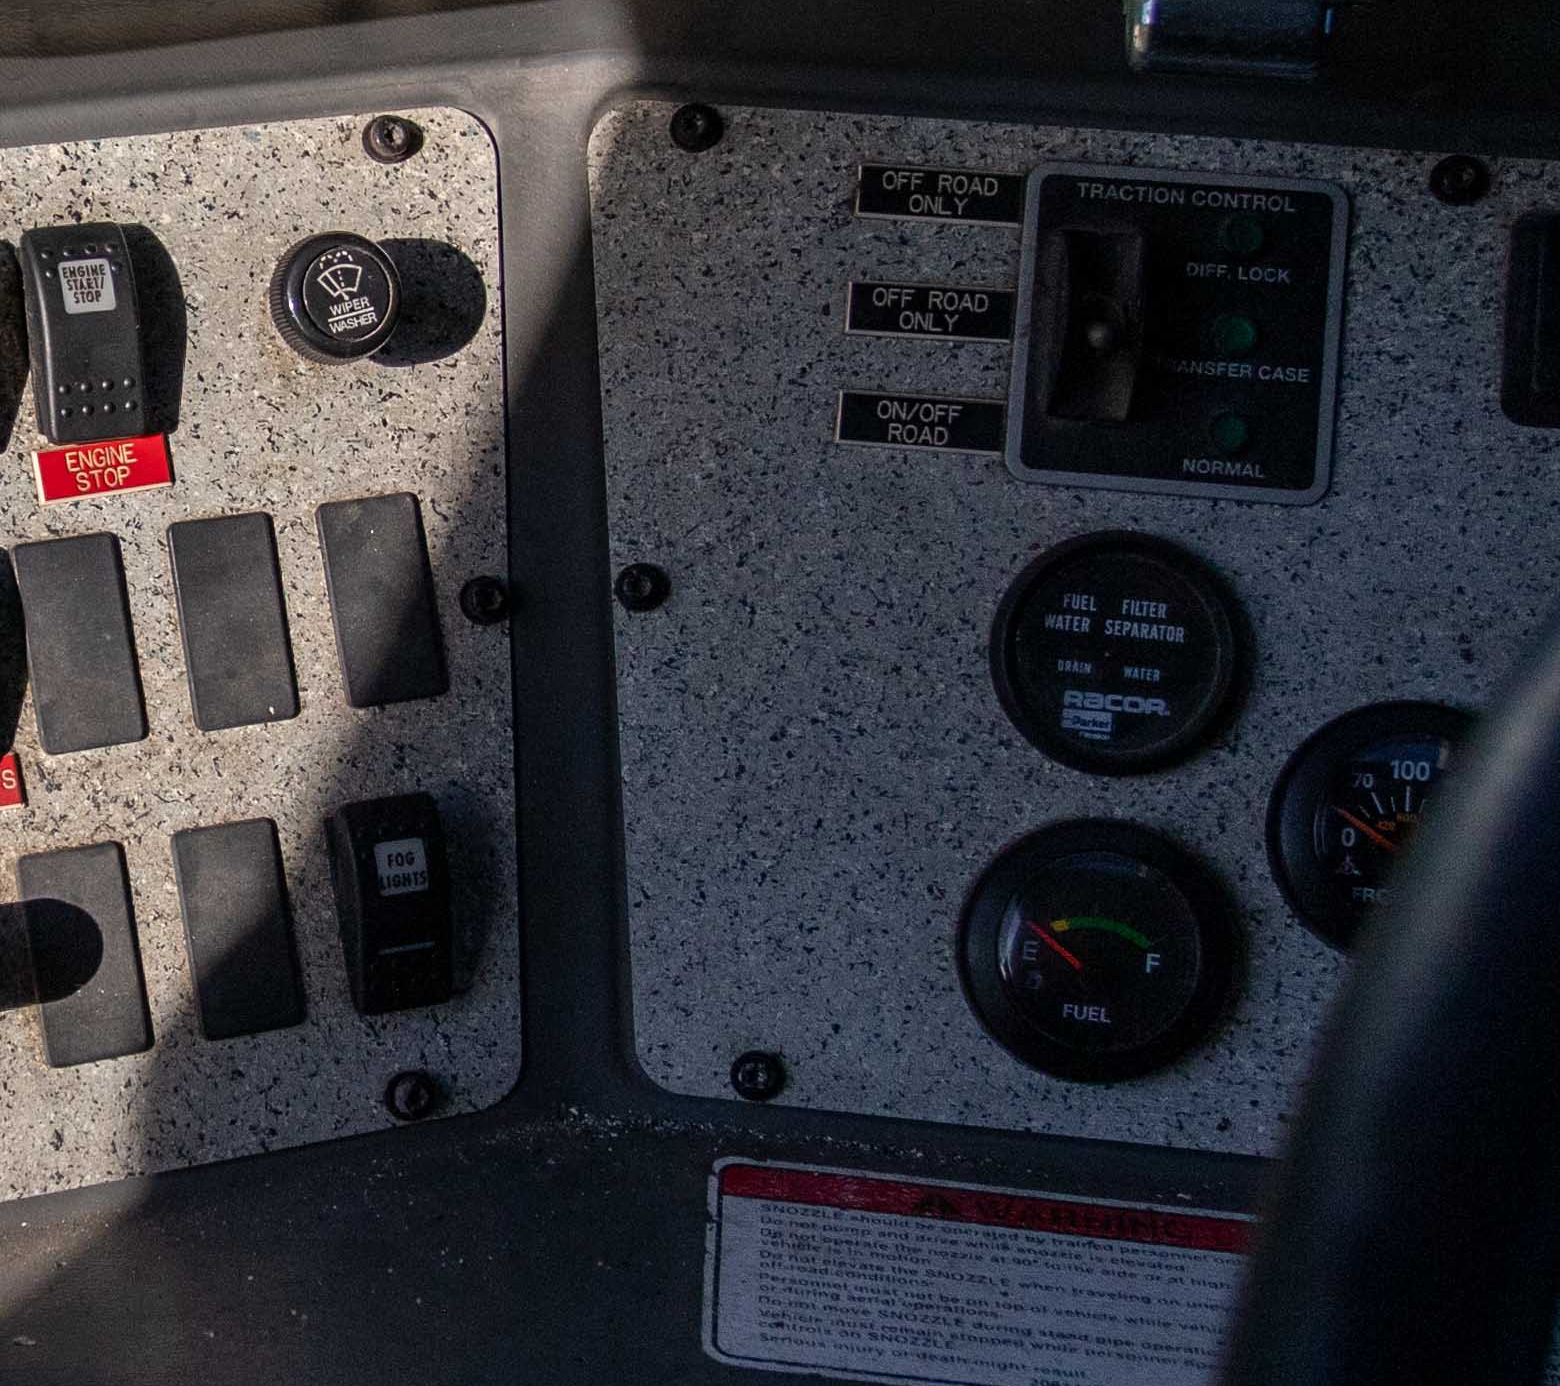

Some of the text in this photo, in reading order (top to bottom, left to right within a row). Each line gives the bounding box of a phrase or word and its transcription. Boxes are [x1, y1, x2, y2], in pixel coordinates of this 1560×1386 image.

[881, 170, 999, 197] OFF ROAD
[908, 193, 969, 215] ONLY
[1077, 181, 1296, 213] TRACTION CONTROL
[61, 263, 107, 279] ENGINE
[1185, 262, 1292, 285] DIFF. LOCK
[73, 290, 103, 305] STOP
[329, 296, 371, 316] WIPER
[872, 287, 989, 313] OFF ROAD
[329, 312, 378, 333] WASHER
[899, 311, 959, 333] ONLY
[1258, 365, 1310, 383] CASE
[876, 399, 965, 424] ON/OFF
[887, 422, 950, 446] ROAD
[64, 443, 138, 473] ENGINE
[1182, 458, 1265, 478] NORMAL
[75, 465, 131, 492] STOP
[1063, 593, 1167, 619] FUEL FILTER
[1044, 614, 1185, 644] WATER SEPARATOR
[1057, 659, 1161, 682] DRAIN WATER
[1352, 773, 1374, 789] 70
[1390, 759, 1430, 782] 100
[1341, 827, 1356, 847] 0
[387, 851, 416, 869] FOG
[380, 870, 427, 889] LIGHTS
[1023, 940, 1040, 962] E
[1145, 953, 1161, 974] F
[1062, 1003, 1112, 1024] FUEL
